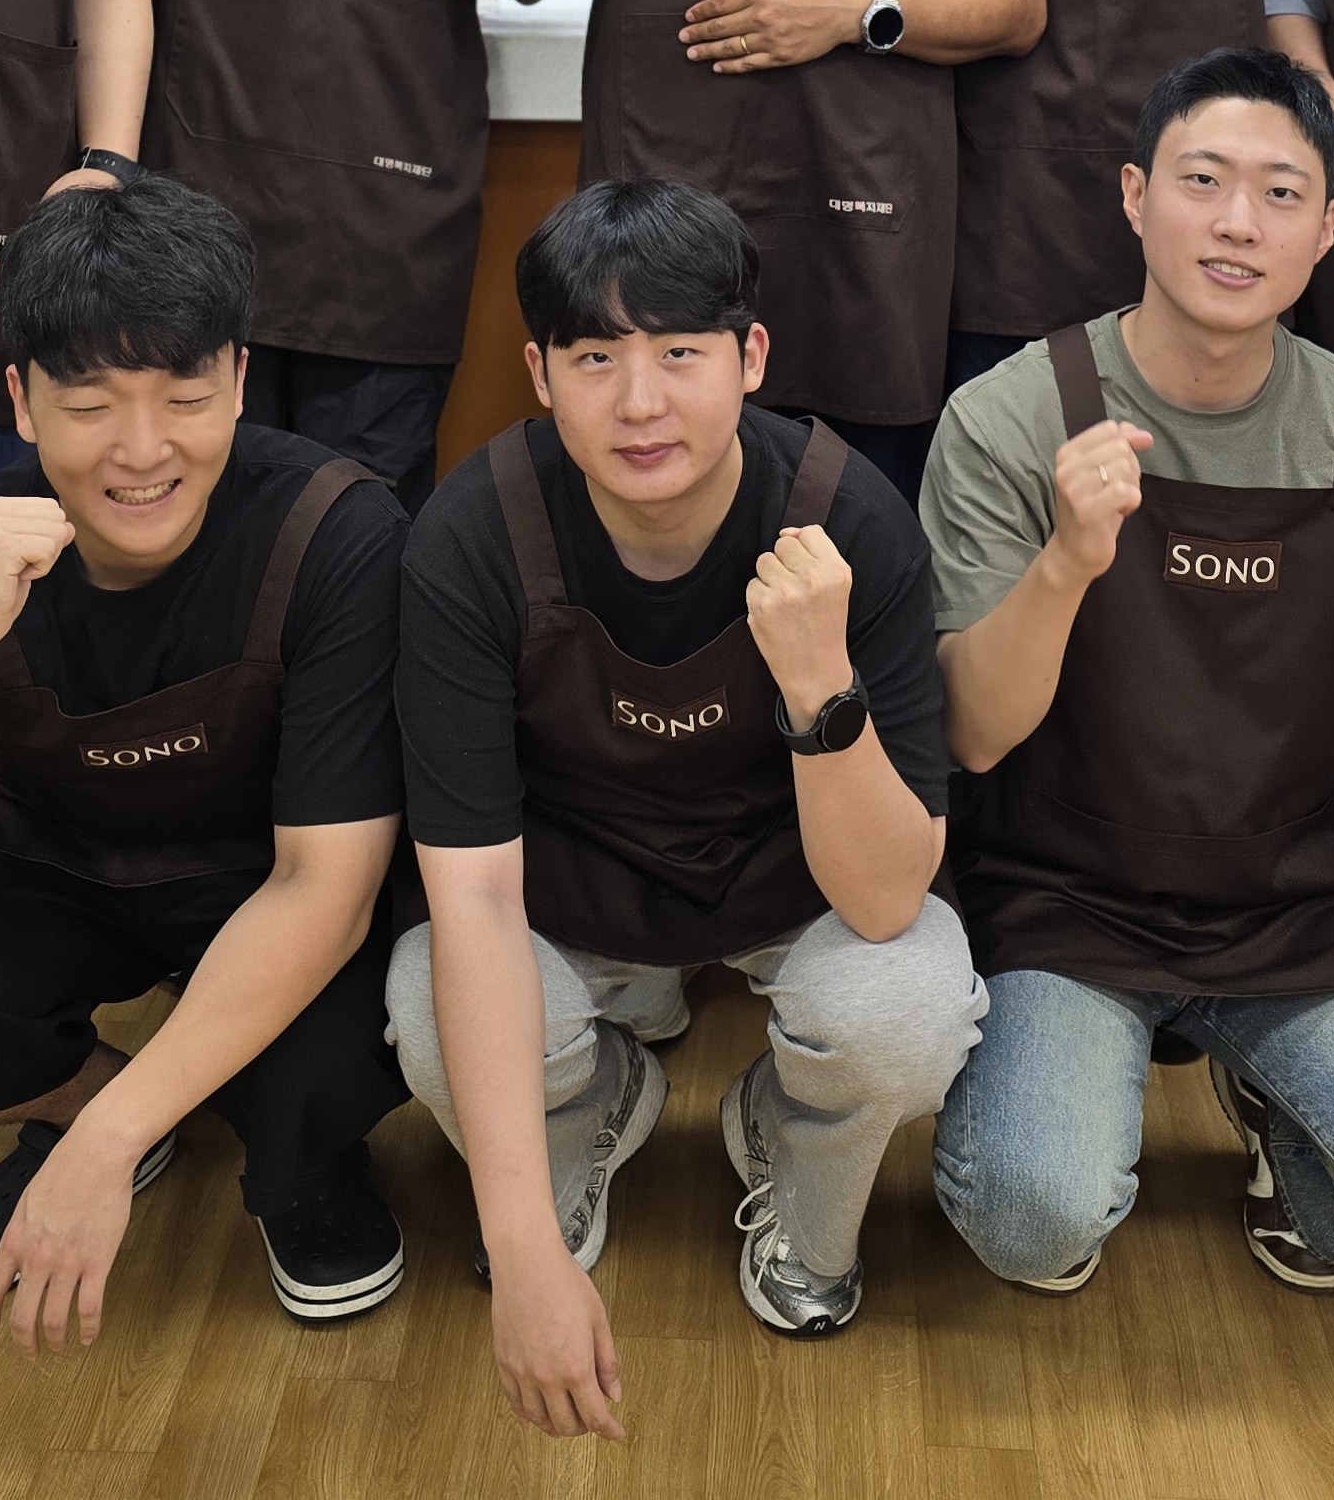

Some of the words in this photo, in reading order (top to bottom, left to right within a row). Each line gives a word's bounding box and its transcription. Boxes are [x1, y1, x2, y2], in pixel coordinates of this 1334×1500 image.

[1169, 544, 1275, 584] SONO
[617, 700, 724, 738] SONO
[87, 736, 201, 766] SONO
